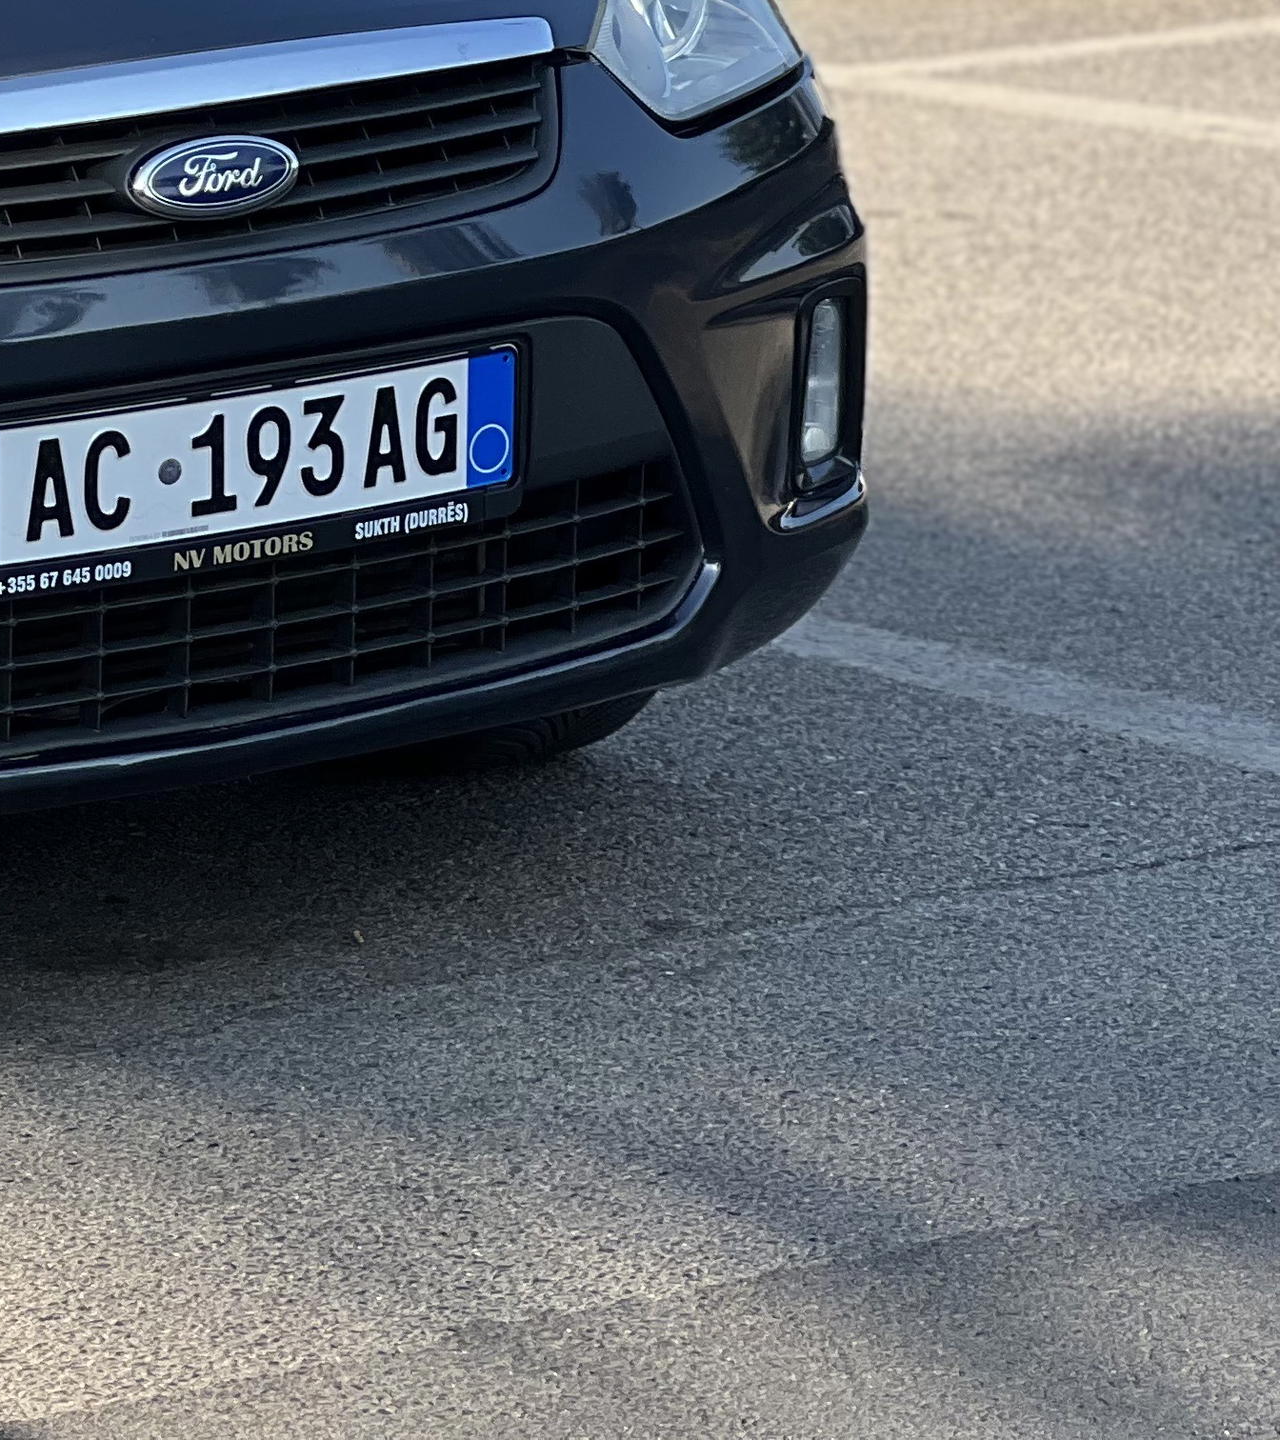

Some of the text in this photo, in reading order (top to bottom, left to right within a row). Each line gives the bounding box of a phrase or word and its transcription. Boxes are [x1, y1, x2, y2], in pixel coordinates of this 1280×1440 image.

[178, 151, 263, 197] Ford
[26, 377, 458, 543] AC 193 AG
[354, 515, 401, 540] SUKTH
[173, 548, 206, 572] NV
[212, 531, 314, 566] MOTORS
[40, 571, 59, 590] 67
[62, 566, 91, 586] 645
[94, 560, 132, 582] 0009
